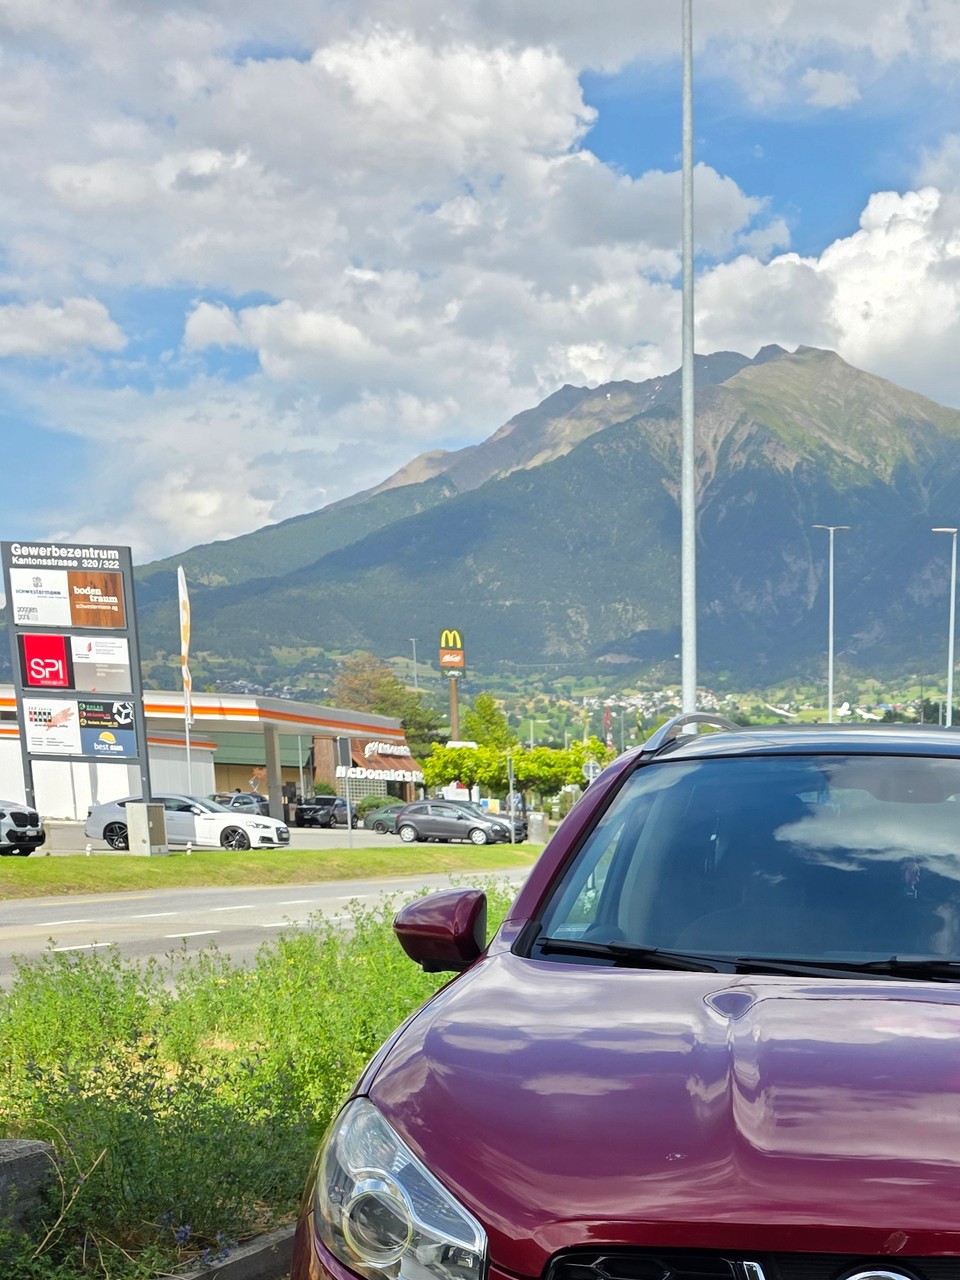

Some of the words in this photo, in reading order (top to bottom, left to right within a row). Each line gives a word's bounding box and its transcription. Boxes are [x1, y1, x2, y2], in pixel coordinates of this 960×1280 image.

[11, 543, 119, 559] Gewerbezentrum
[12, 556, 78, 567] Kantonsstrasse
[73, 586, 102, 595] boden
[89, 594, 118, 603] traum
[30, 658, 64, 679] SPI
[93, 742, 110, 751] best
